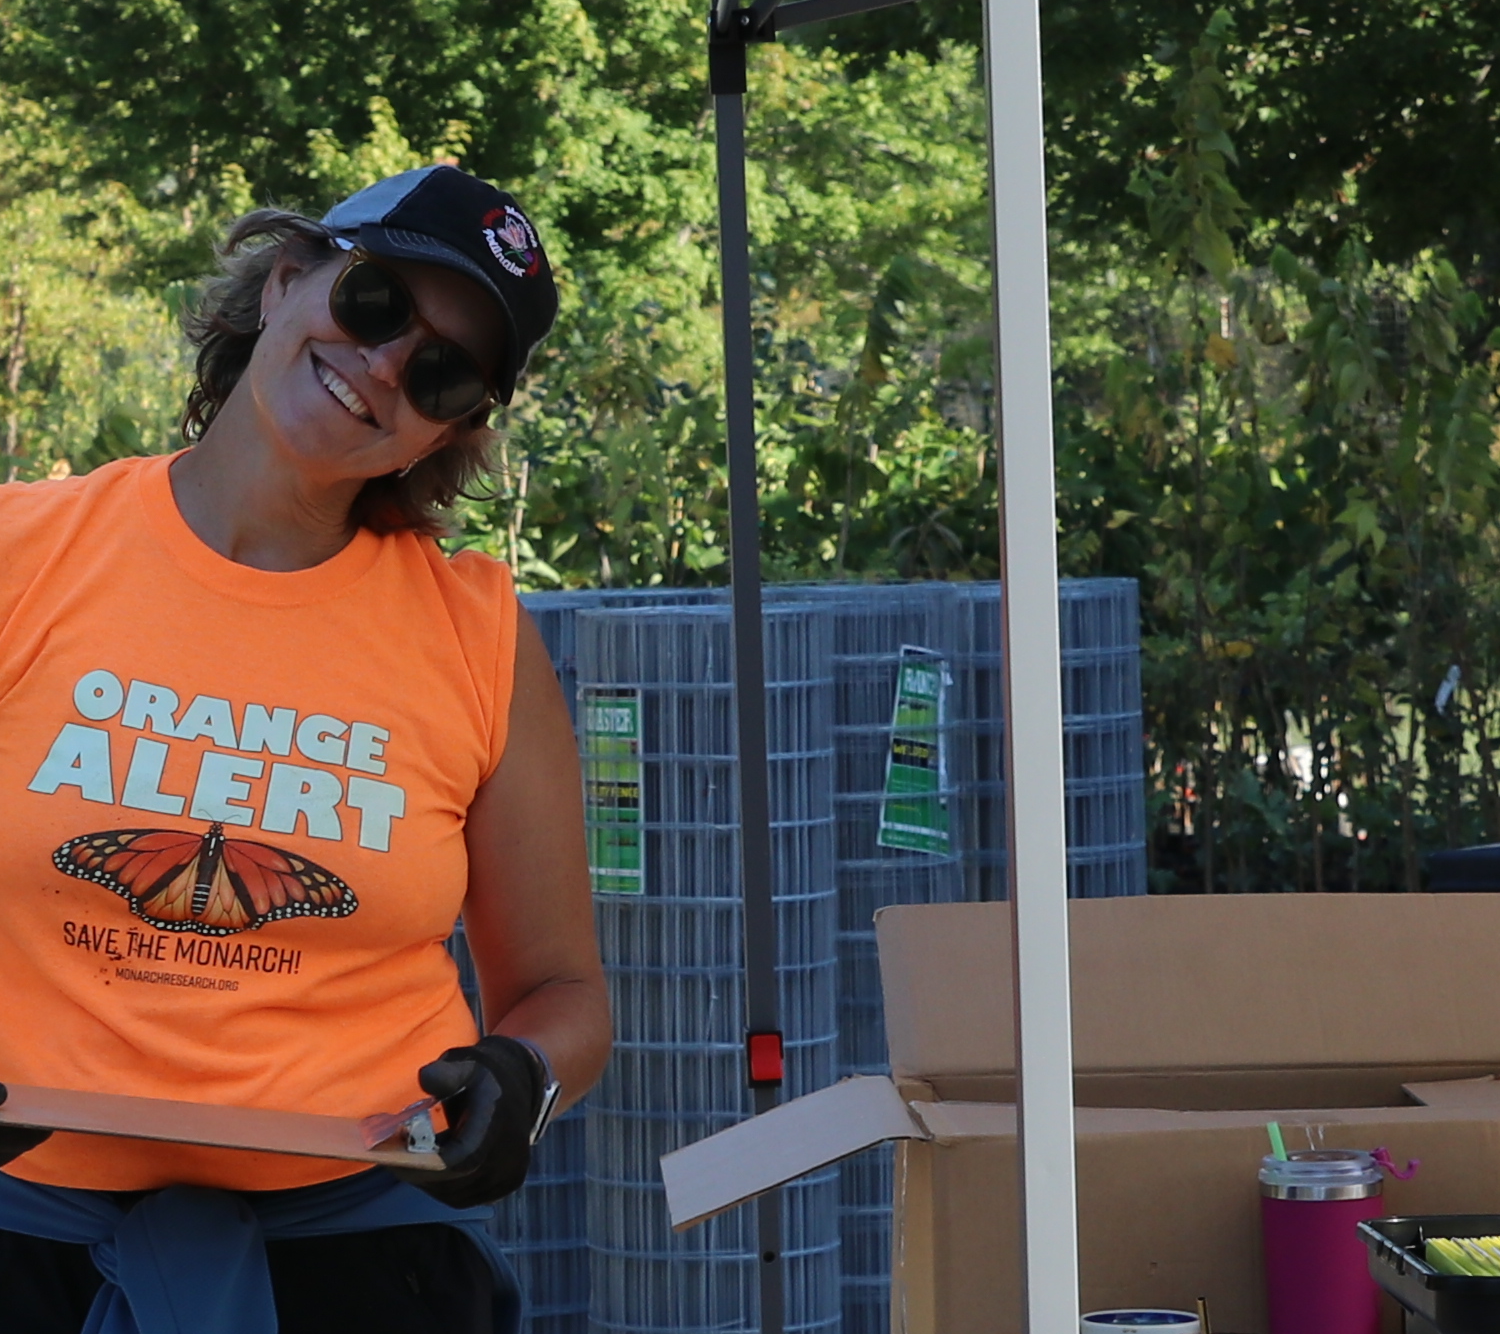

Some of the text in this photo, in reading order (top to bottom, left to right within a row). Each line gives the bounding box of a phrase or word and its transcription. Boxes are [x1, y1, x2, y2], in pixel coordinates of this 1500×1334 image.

[73, 669, 391, 776] ORANGE
[26, 722, 406, 853] ALERT
[63, 921, 302, 975] SAVE THE MONARCH!
[115, 967, 240, 992] MONARCHRESEARCH.ORG
